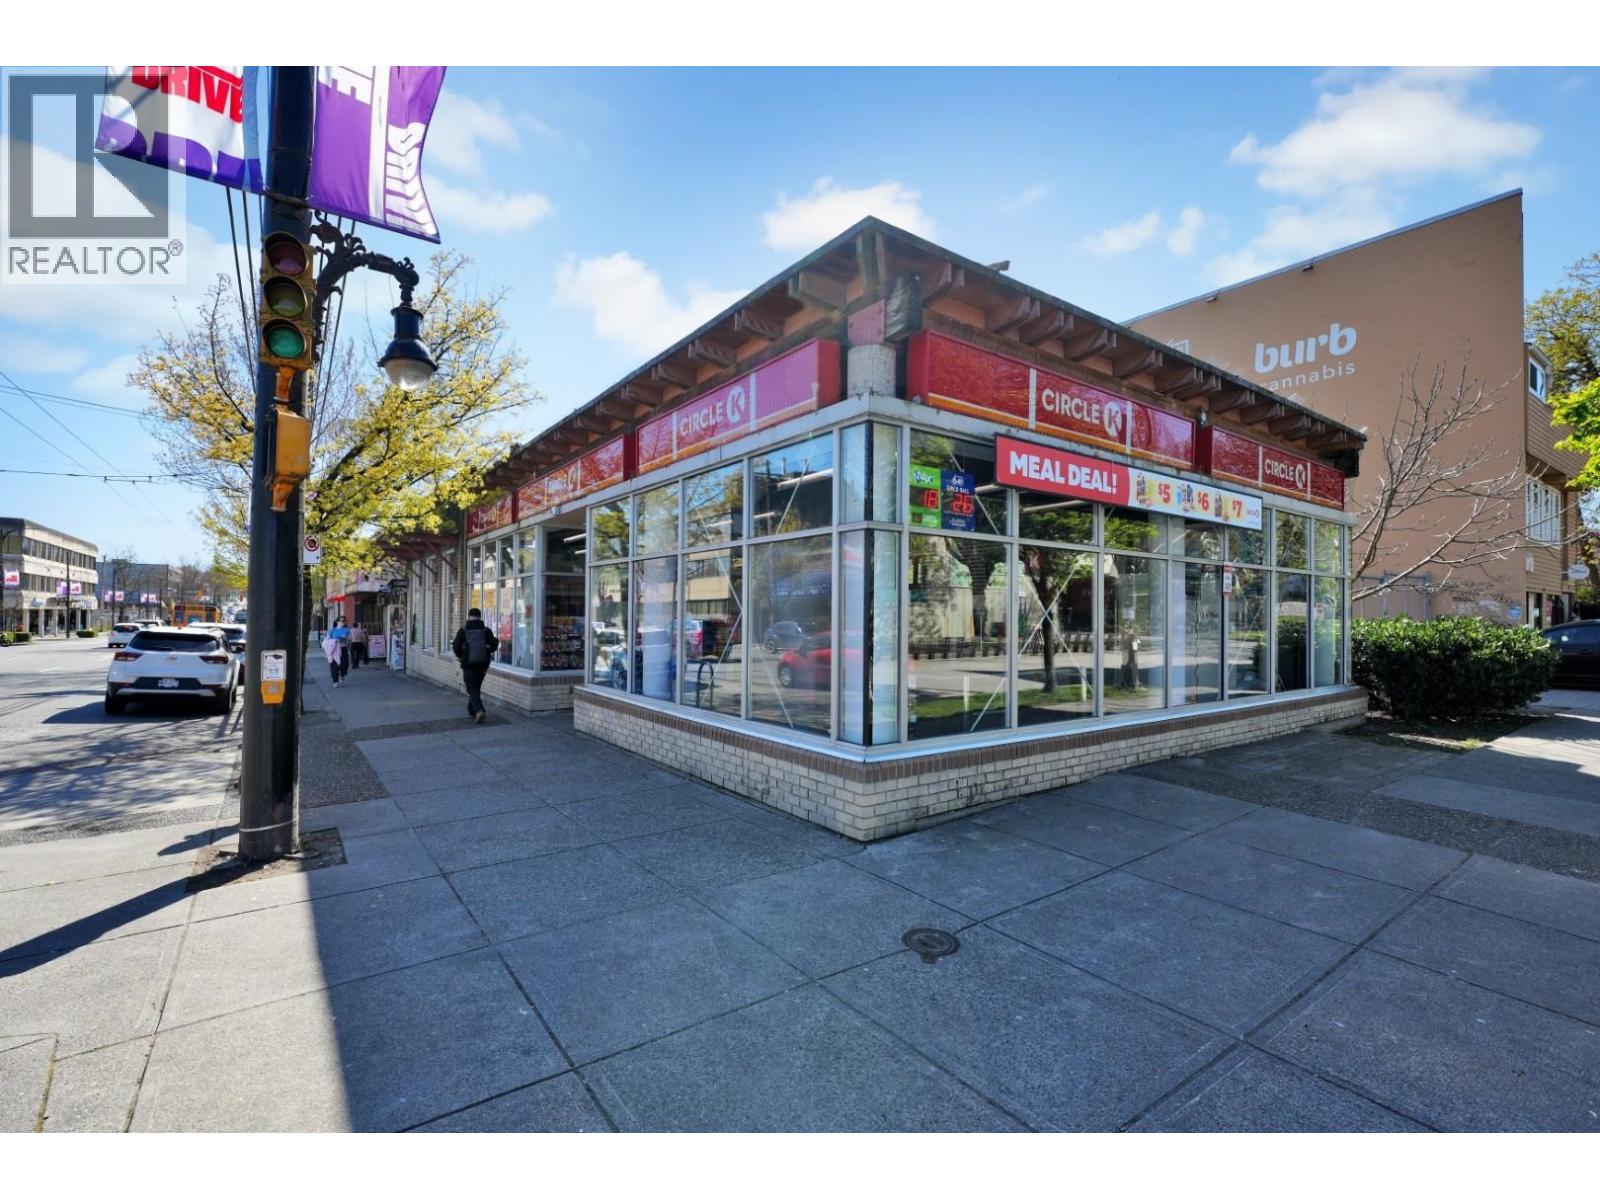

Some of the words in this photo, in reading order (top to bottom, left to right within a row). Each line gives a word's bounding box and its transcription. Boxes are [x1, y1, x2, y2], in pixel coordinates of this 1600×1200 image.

[1254, 322, 1357, 374] burb
[681, 401, 723, 436] CIRCLE
[1041, 388, 1101, 424] CIRCLE
[1103, 402, 1121, 437] K
[1009, 451, 1065, 484] MEAL
[1068, 463, 1117, 494] DEAL!
[1264, 458, 1294, 481] CIRCLE
[1158, 482, 1171, 504] $5
[1197, 492, 1209, 512] $6
[1232, 499, 1243, 518] $7
